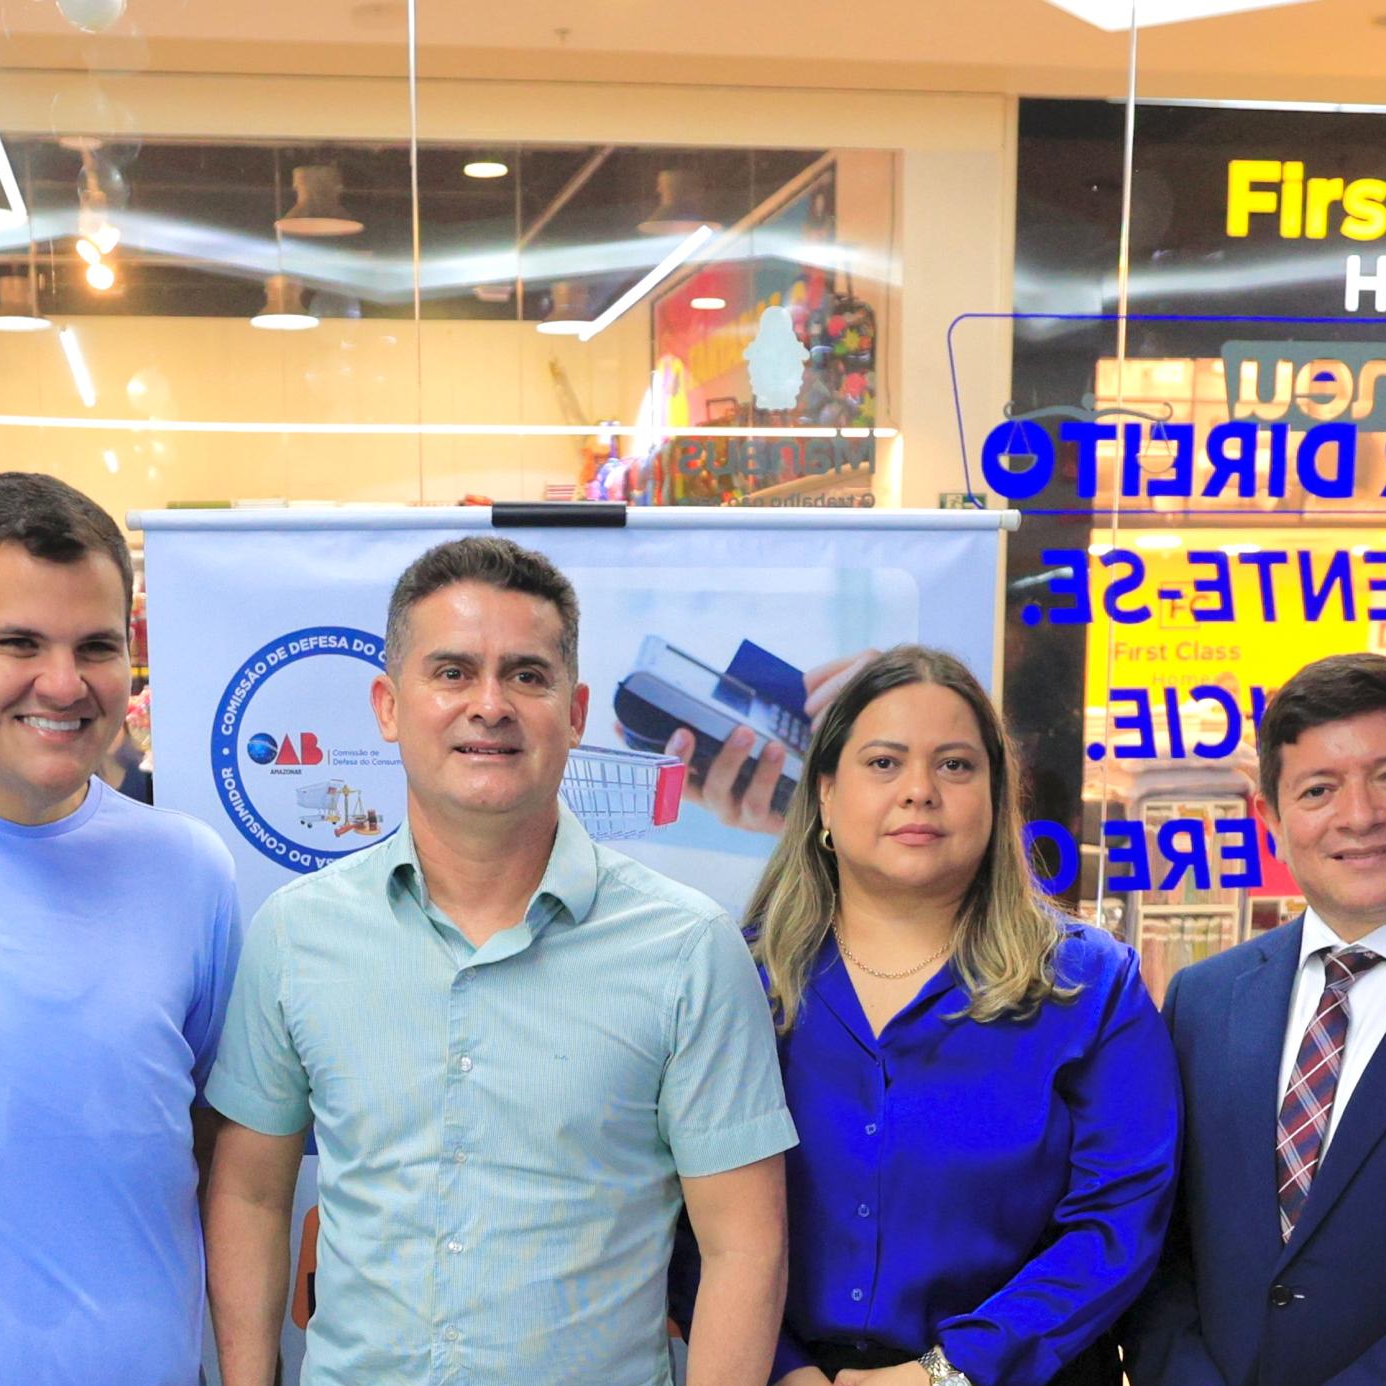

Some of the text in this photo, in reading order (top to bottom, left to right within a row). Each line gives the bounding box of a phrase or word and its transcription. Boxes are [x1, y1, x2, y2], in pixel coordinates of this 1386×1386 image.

[1115, 641, 1241, 662] First Class
[221, 636, 376, 735] COMISSÃO DE DEFESA DO
[333, 749, 380, 757] Comissão de
[333, 758, 358, 766] Defesa
[359, 758, 370, 766] do
[221, 767, 311, 867] CONSUMIDOR DO
